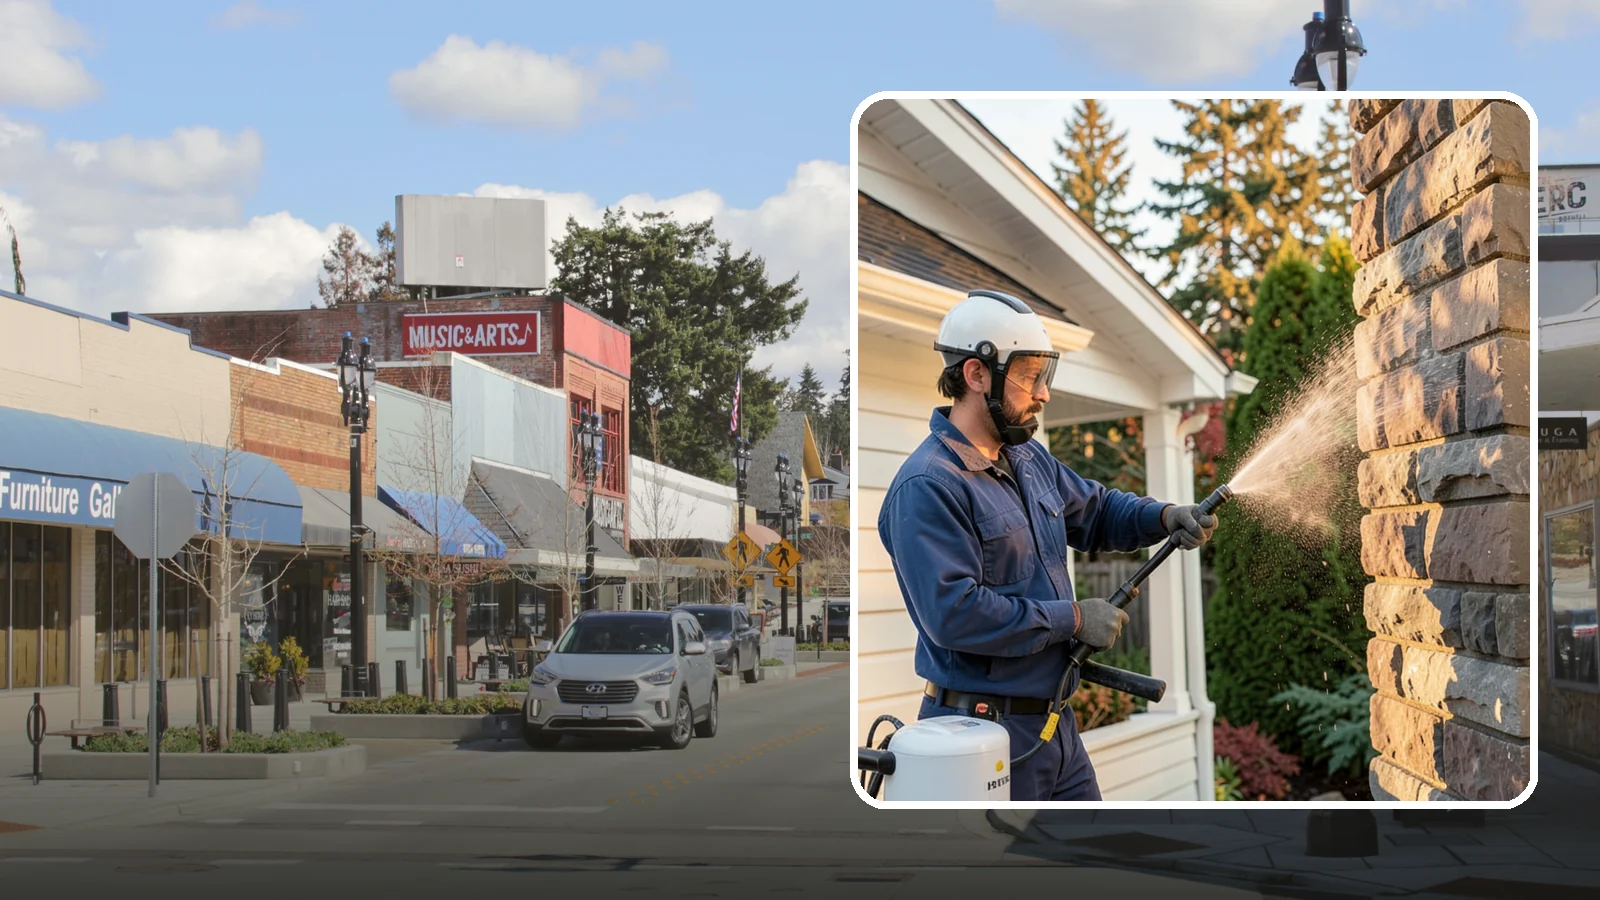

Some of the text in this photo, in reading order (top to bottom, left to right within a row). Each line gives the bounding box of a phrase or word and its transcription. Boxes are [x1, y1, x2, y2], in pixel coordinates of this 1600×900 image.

[409, 323, 519, 348] MUSIC&ARTS
[1541, 428, 1577, 436] UGA
[0, 471, 121, 519] Furniture Gal
